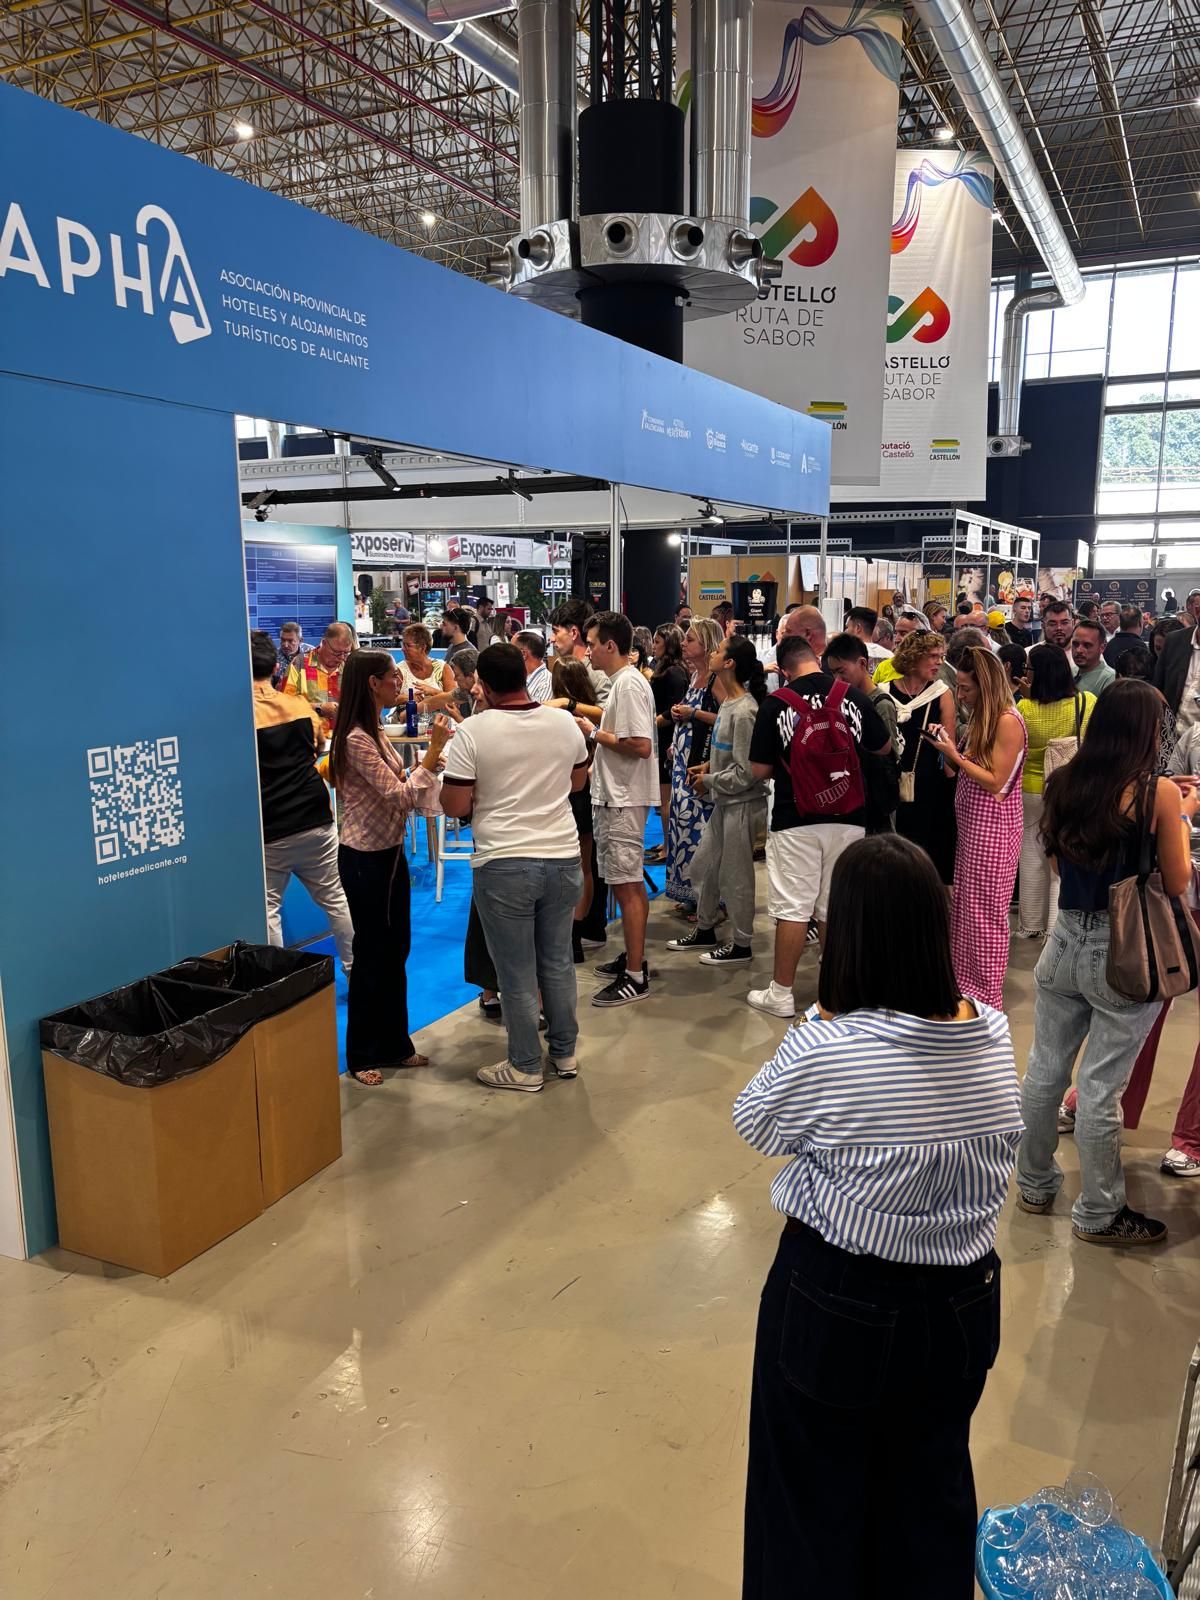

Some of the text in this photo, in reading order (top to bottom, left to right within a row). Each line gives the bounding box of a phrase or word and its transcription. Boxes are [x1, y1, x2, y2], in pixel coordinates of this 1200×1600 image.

[0, 202, 212, 344] APHA
[220, 269, 367, 327] ASOCIACIÓN PROVINCIAL DE
[222, 294, 369, 348] HOTELES Y ALOJAMIENTOS
[736, 306, 824, 327] RUTA DE
[223, 320, 370, 370] TURÍSTICOS DE ALICANTE
[743, 327, 815, 347] SABOR
[885, 372, 942, 385] UTA DE
[883, 387, 936, 401] SABOR
[929, 453, 961, 461] CASTELLÓN
[460, 537, 517, 563] Exposervi
[422, 580, 456, 591] Exposervi
[545, 578, 564, 589] LED
[98, 855, 187, 885] hotelesdealicante.org
